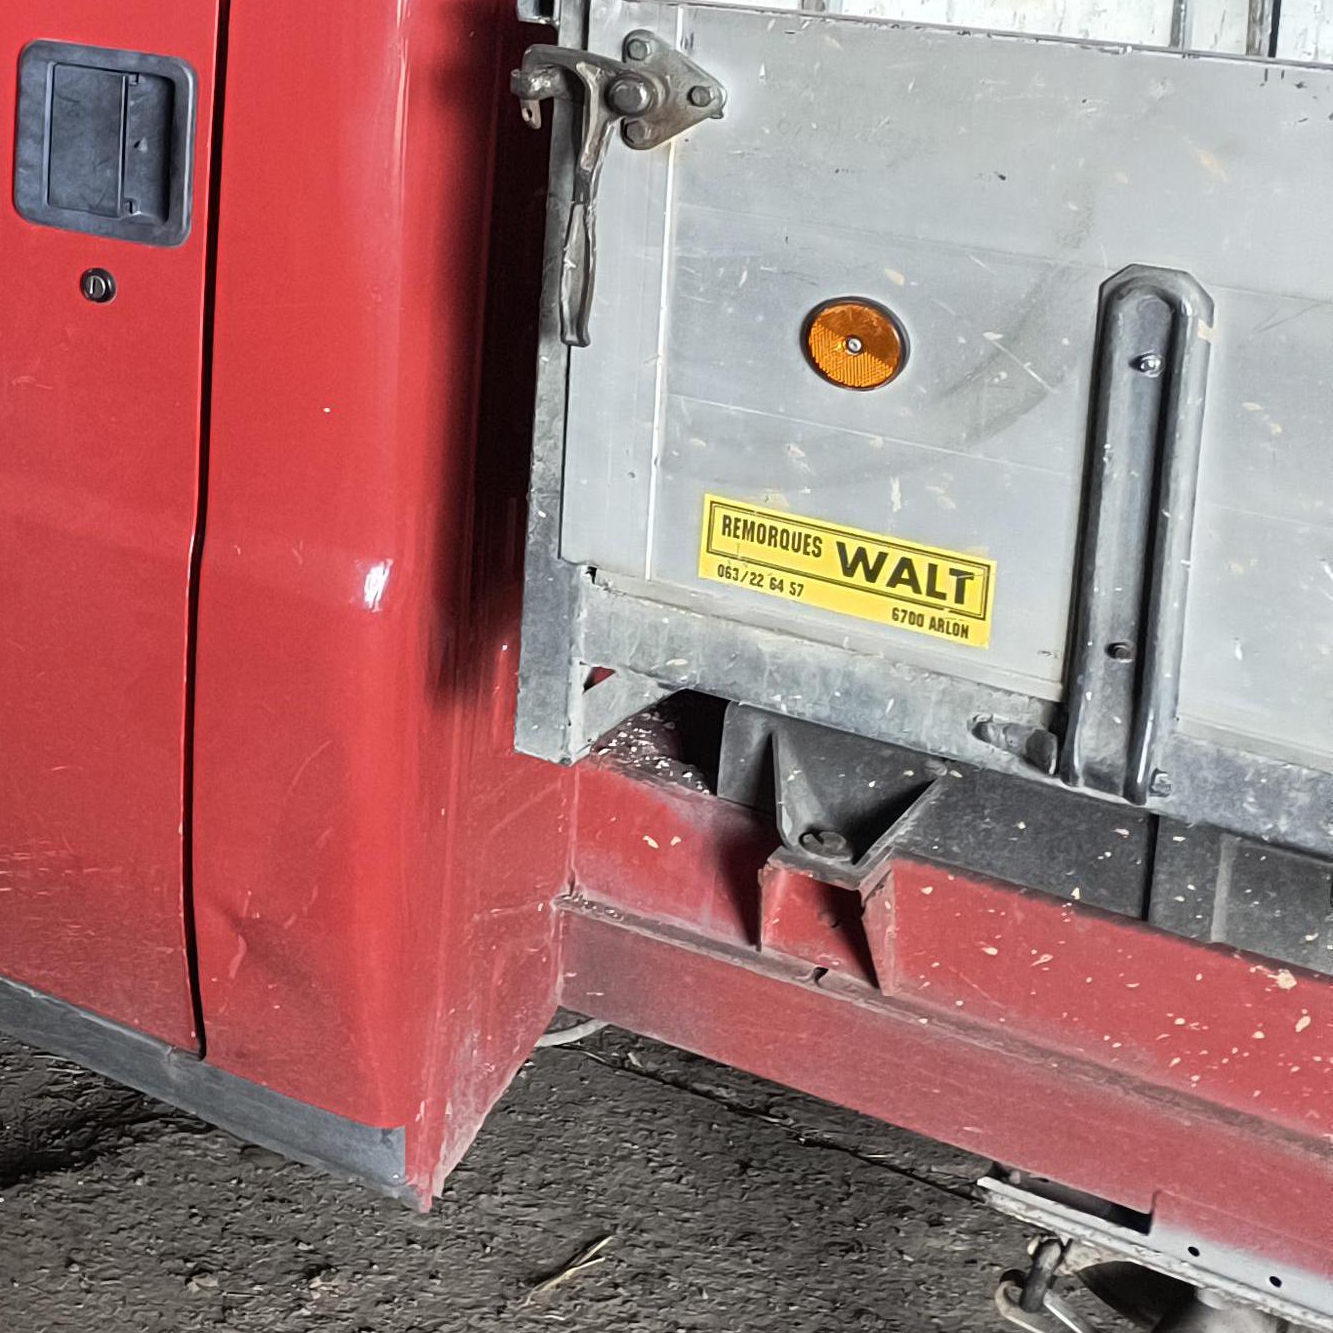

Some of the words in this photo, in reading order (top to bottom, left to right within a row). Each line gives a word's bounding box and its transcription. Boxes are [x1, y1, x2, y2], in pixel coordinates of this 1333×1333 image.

[721, 515, 823, 558] REMORQUES
[836, 541, 975, 605] WALT
[717, 564, 764, 588] 063/22
[769, 576, 784, 593] 64
[789, 581, 804, 597] 57
[891, 607, 924, 628] 6700
[928, 616, 969, 639] ARLON
